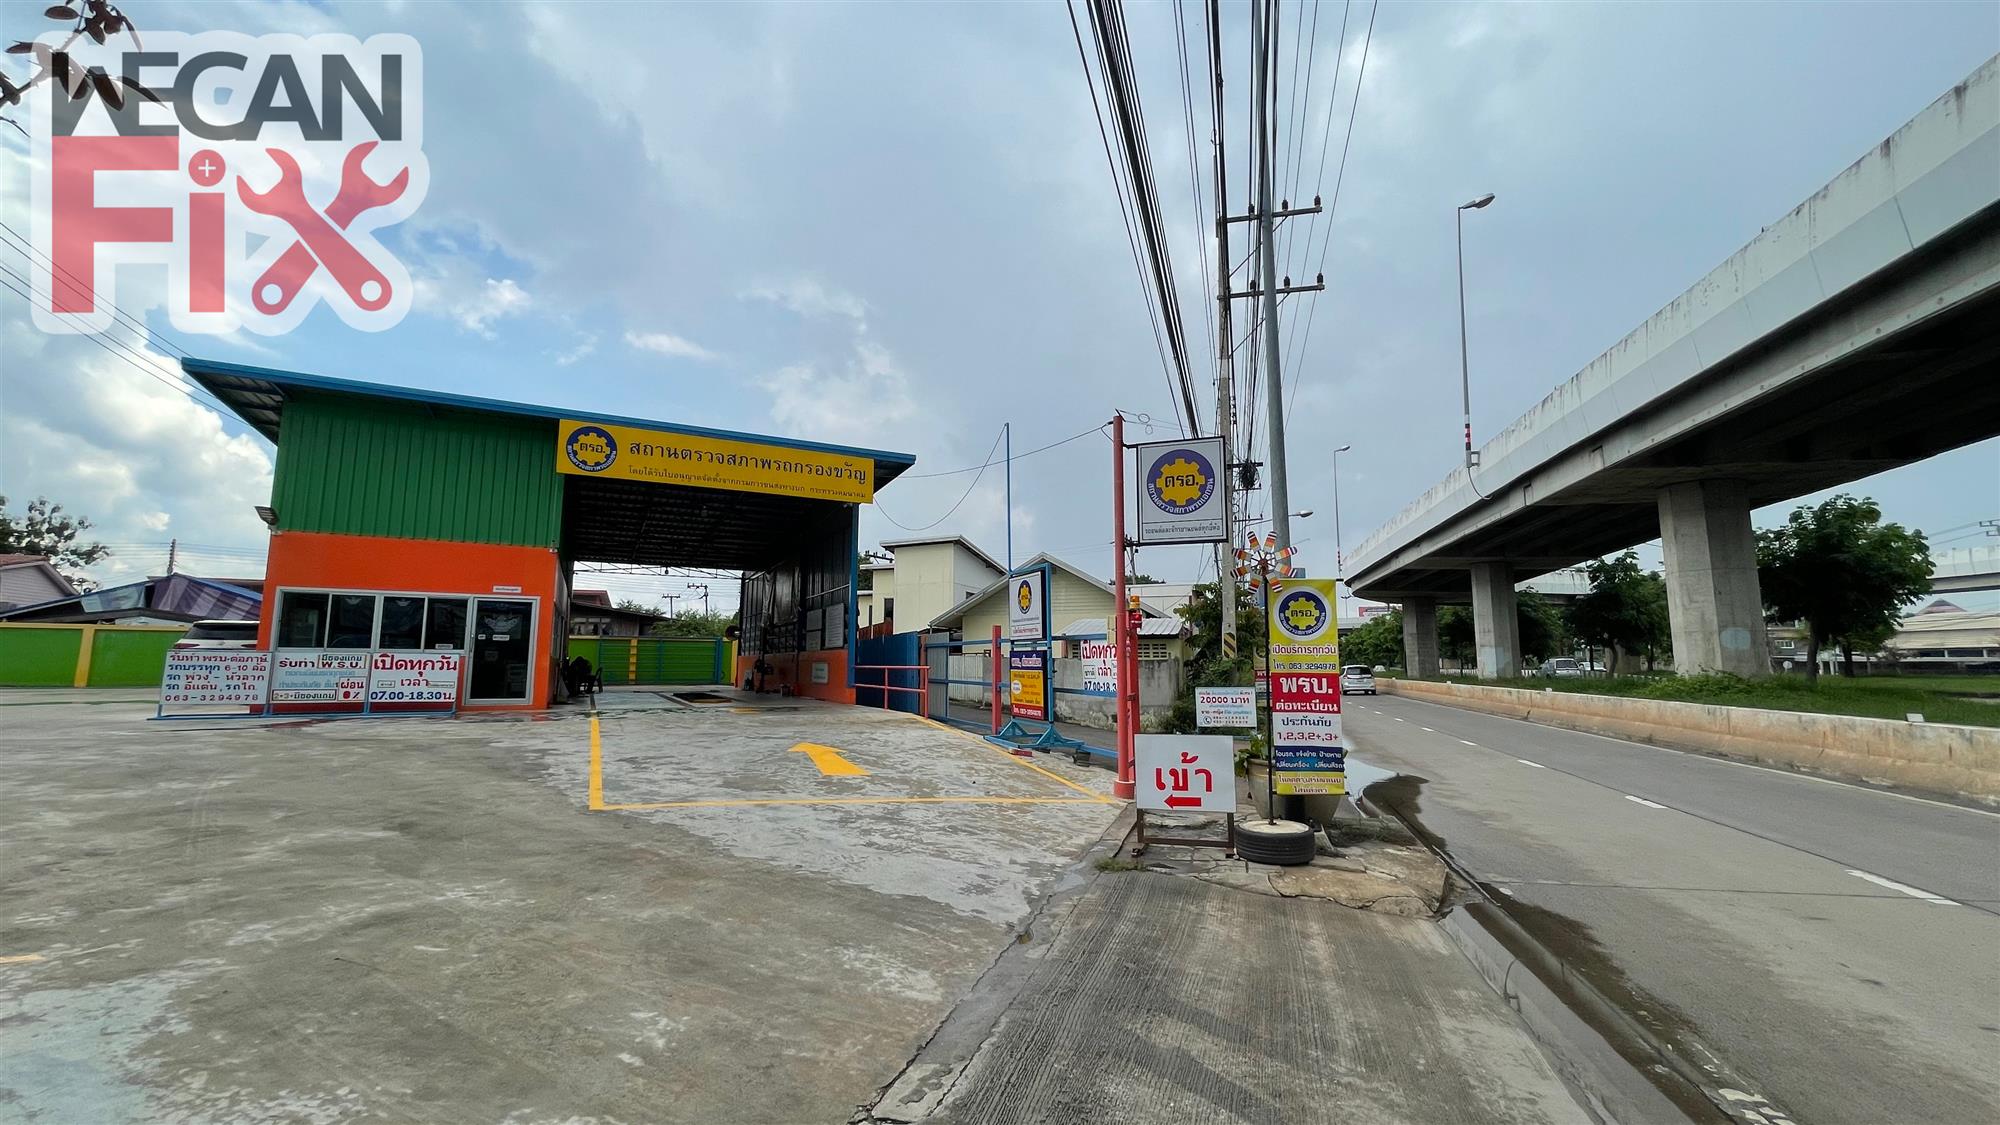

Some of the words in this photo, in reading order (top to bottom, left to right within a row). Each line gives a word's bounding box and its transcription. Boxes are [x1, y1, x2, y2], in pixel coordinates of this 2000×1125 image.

[579, 442, 606, 454] ตรอ.
[630, 442, 866, 484] สถานตรวจสภาพรถกรองขวัญ
[1164, 474, 1199, 488] ตรอ.
[1290, 609, 1315, 618] ตรอ.
[1272, 644, 1336, 656] เปิดบริการทุกวัน
[170, 651, 200, 662] รับทำ
[279, 657, 315, 668] รับทำ
[373, 653, 458, 677] เปิดทุกวัน
[168, 664, 221, 674] รถบรรทุก
[224, 664, 249, 672] 6-10
[1098, 666, 1112, 677] เวลา
[166, 673, 181, 681] รถ
[226, 671, 265, 681] หัวลาก
[165, 683, 180, 691] รถ
[340, 678, 365, 689] ผ่อน
[400, 678, 429, 687] เวลา
[1279, 677, 1333, 694] พรบ.
[164, 694, 259, 702] 063-3294978
[1275, 699, 1338, 712] ต่อทะเบียน
[1281, 715, 1332, 727] ประกันภัย
[1155, 751, 1213, 793] เข้า
